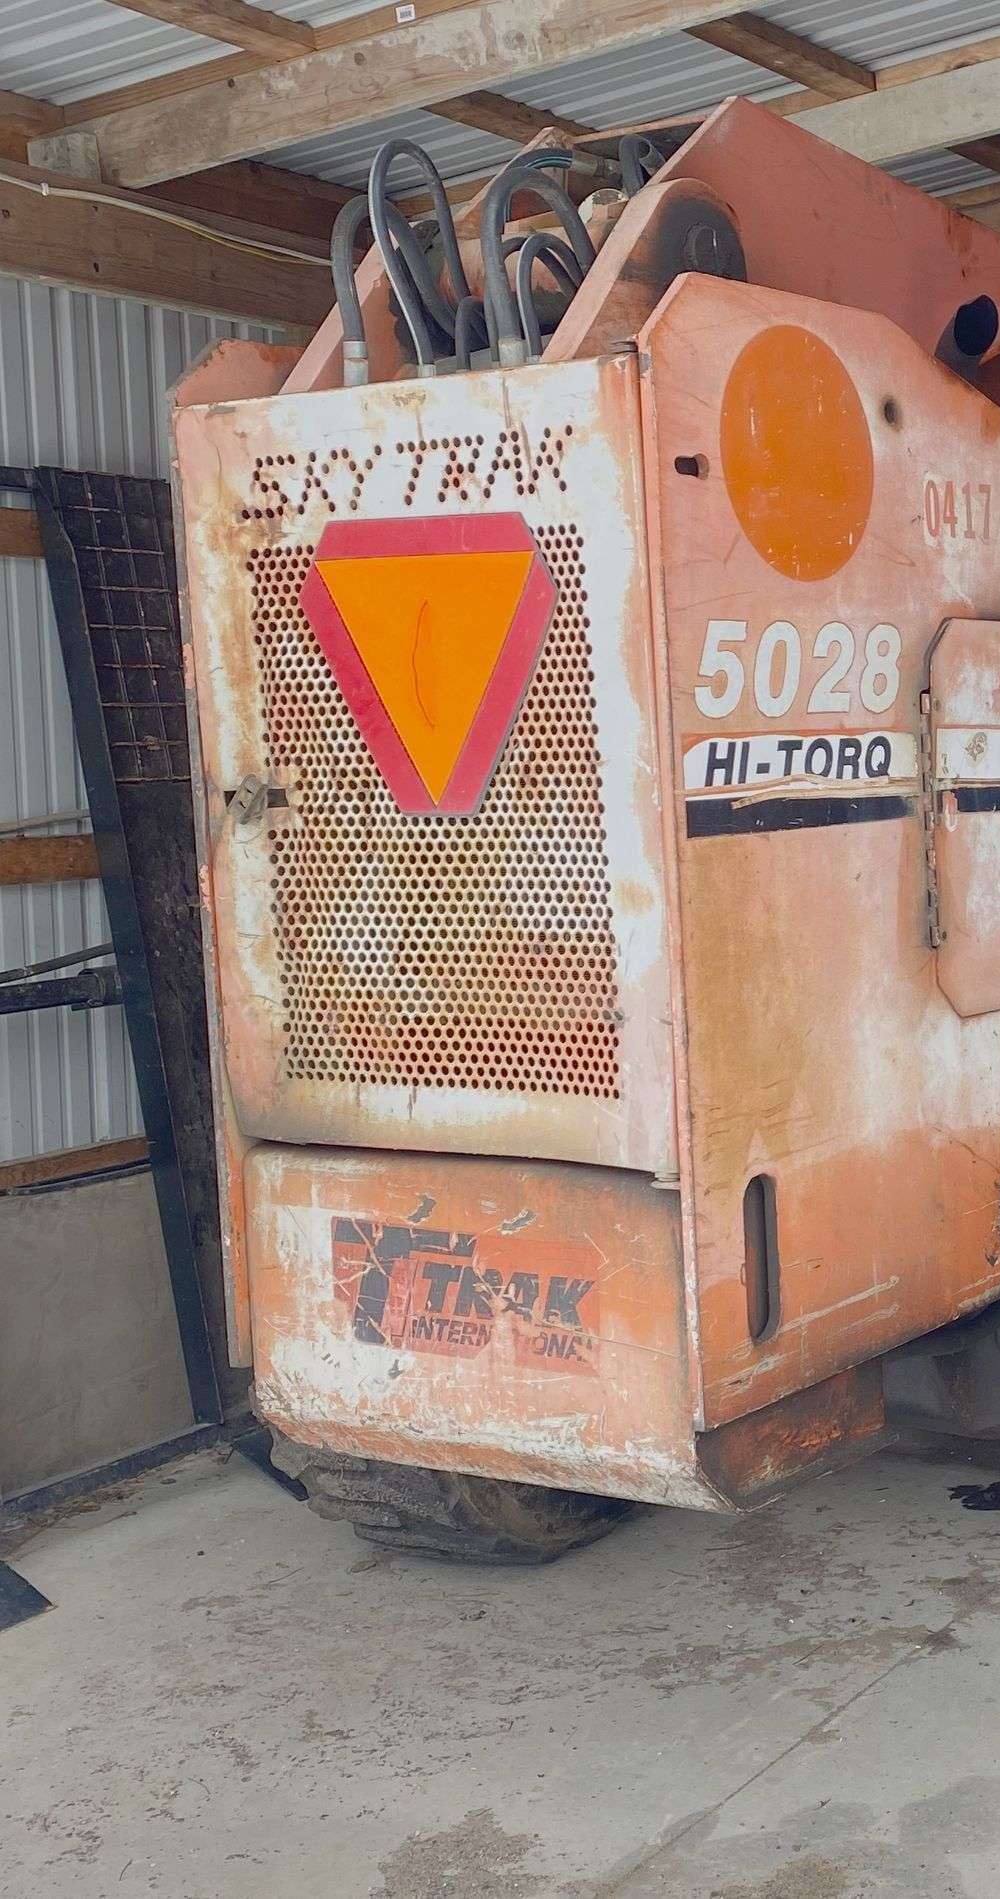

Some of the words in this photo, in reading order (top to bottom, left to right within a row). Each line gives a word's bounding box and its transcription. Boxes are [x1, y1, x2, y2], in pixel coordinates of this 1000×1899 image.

[925, 479, 992, 543] 0417
[694, 619, 902, 719] 5028
[704, 735, 892, 787] HI-TORQ
